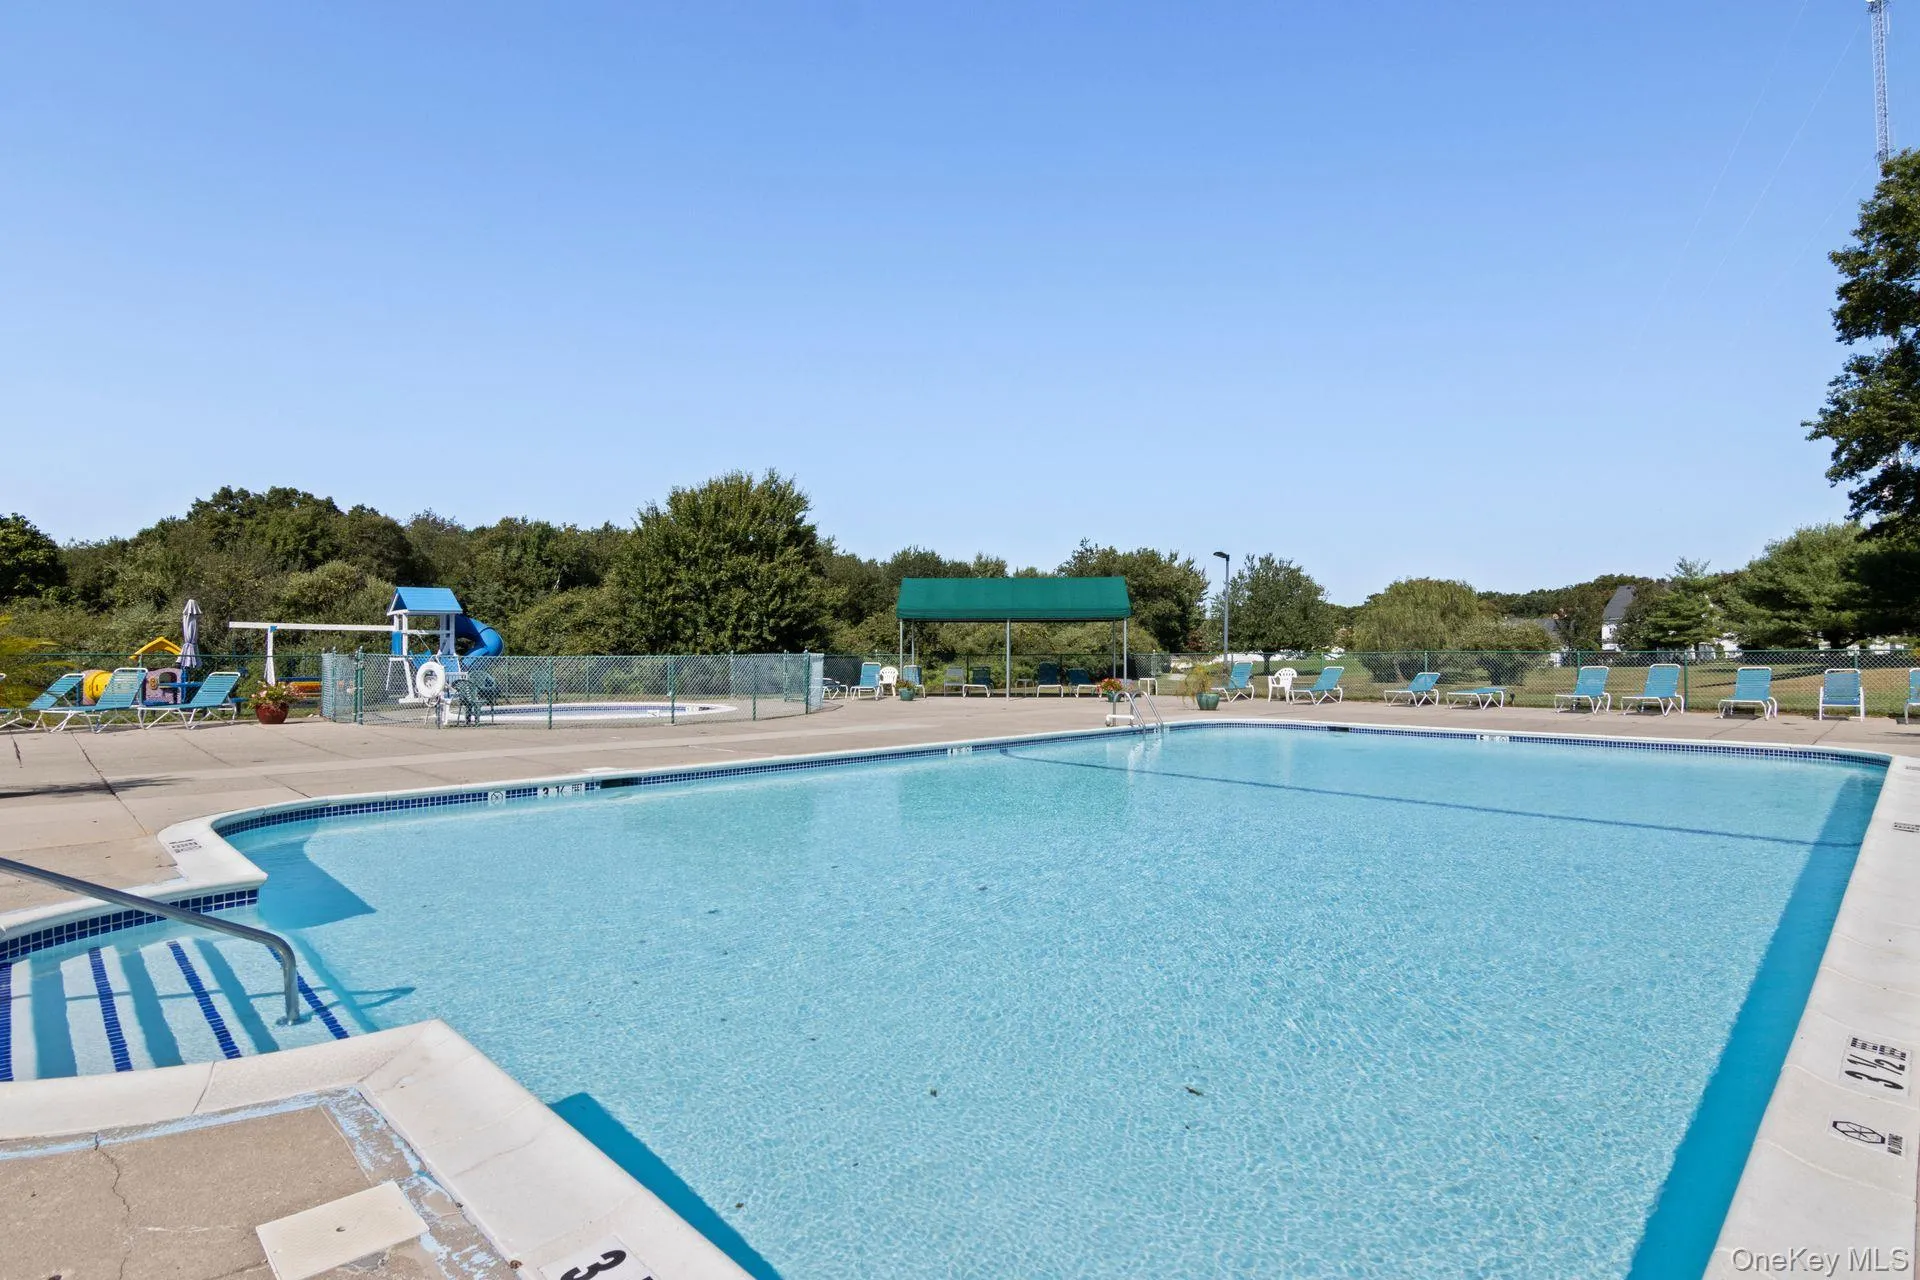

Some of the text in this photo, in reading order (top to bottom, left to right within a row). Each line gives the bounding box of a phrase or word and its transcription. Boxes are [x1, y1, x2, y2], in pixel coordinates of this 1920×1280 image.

[1847, 1054, 1905, 1075] 1/2
[1845, 1070, 1904, 1089] 3
[560, 1250, 627, 1280] 3
